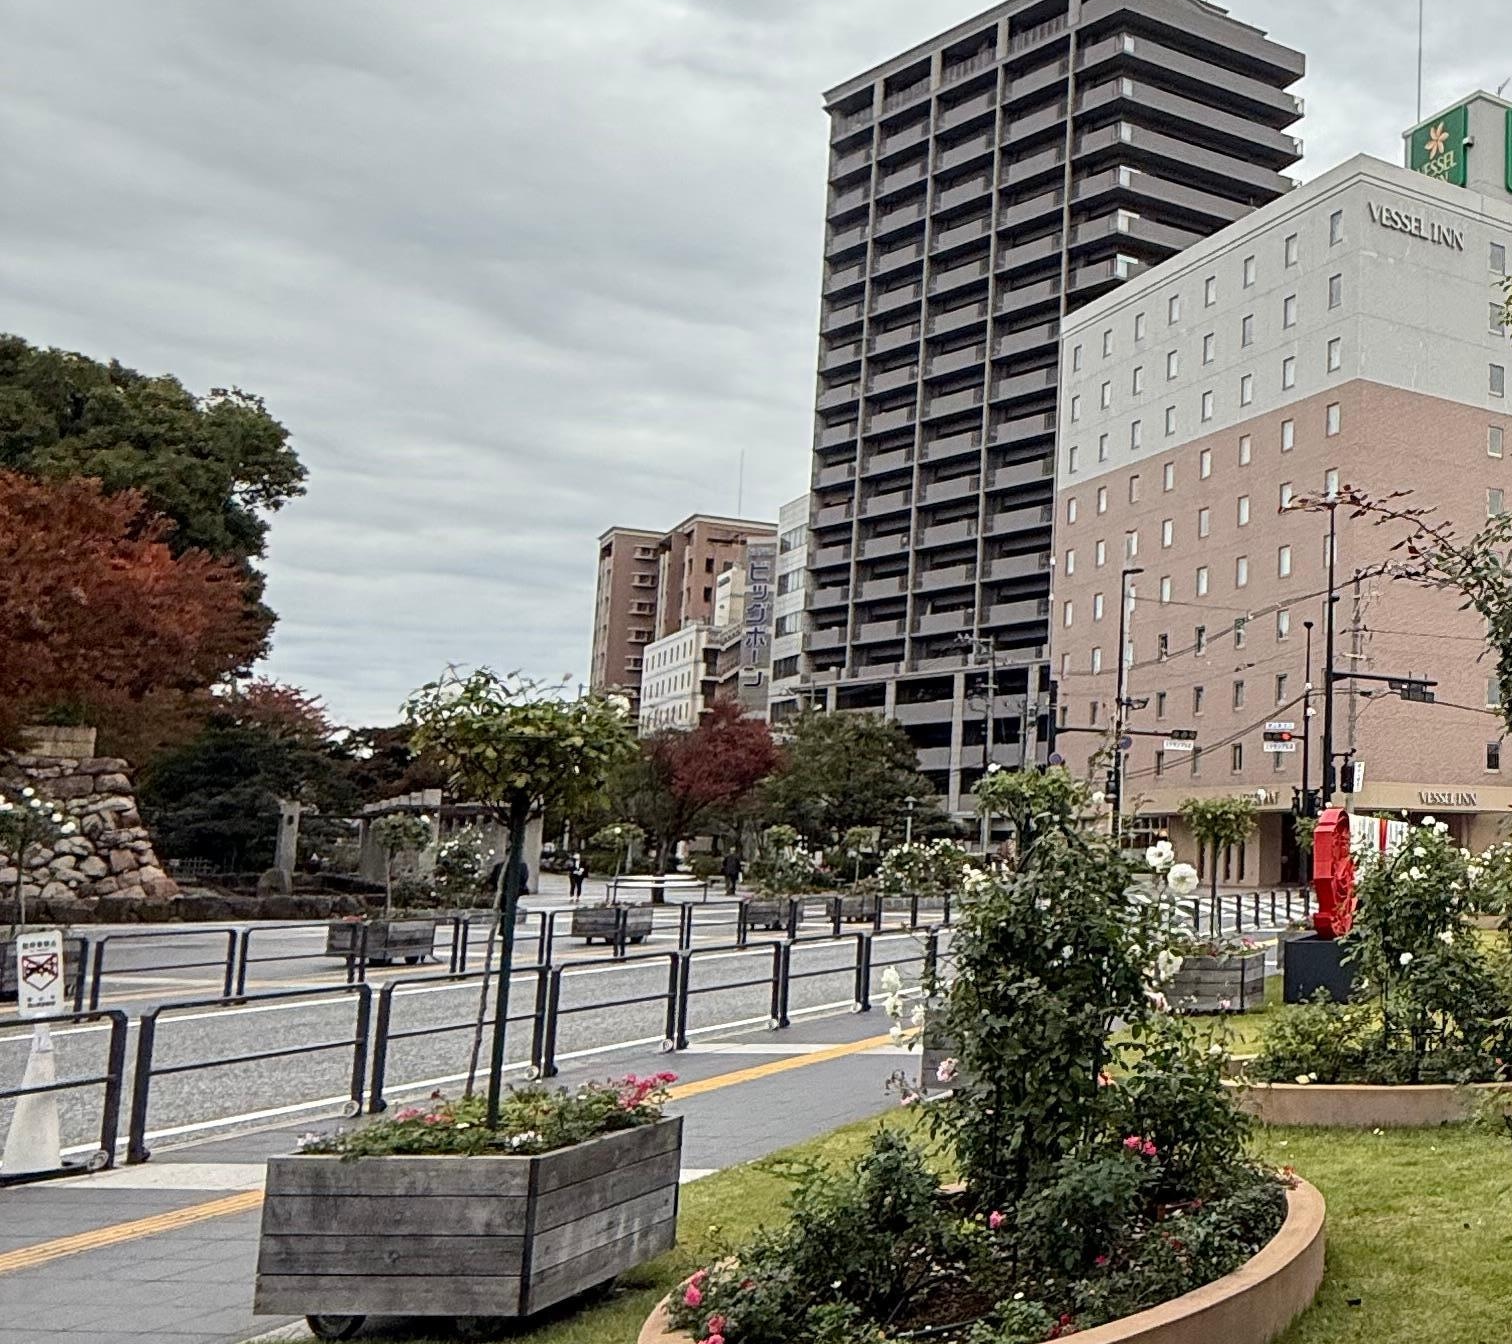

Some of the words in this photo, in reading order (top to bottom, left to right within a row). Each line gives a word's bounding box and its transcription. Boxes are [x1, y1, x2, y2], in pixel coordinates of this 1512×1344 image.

[1368, 201, 1430, 240] VESSEL
[1430, 222, 1464, 251] INN
[1418, 791, 1455, 806] VESSEL
[1456, 792, 1477, 806] INN
